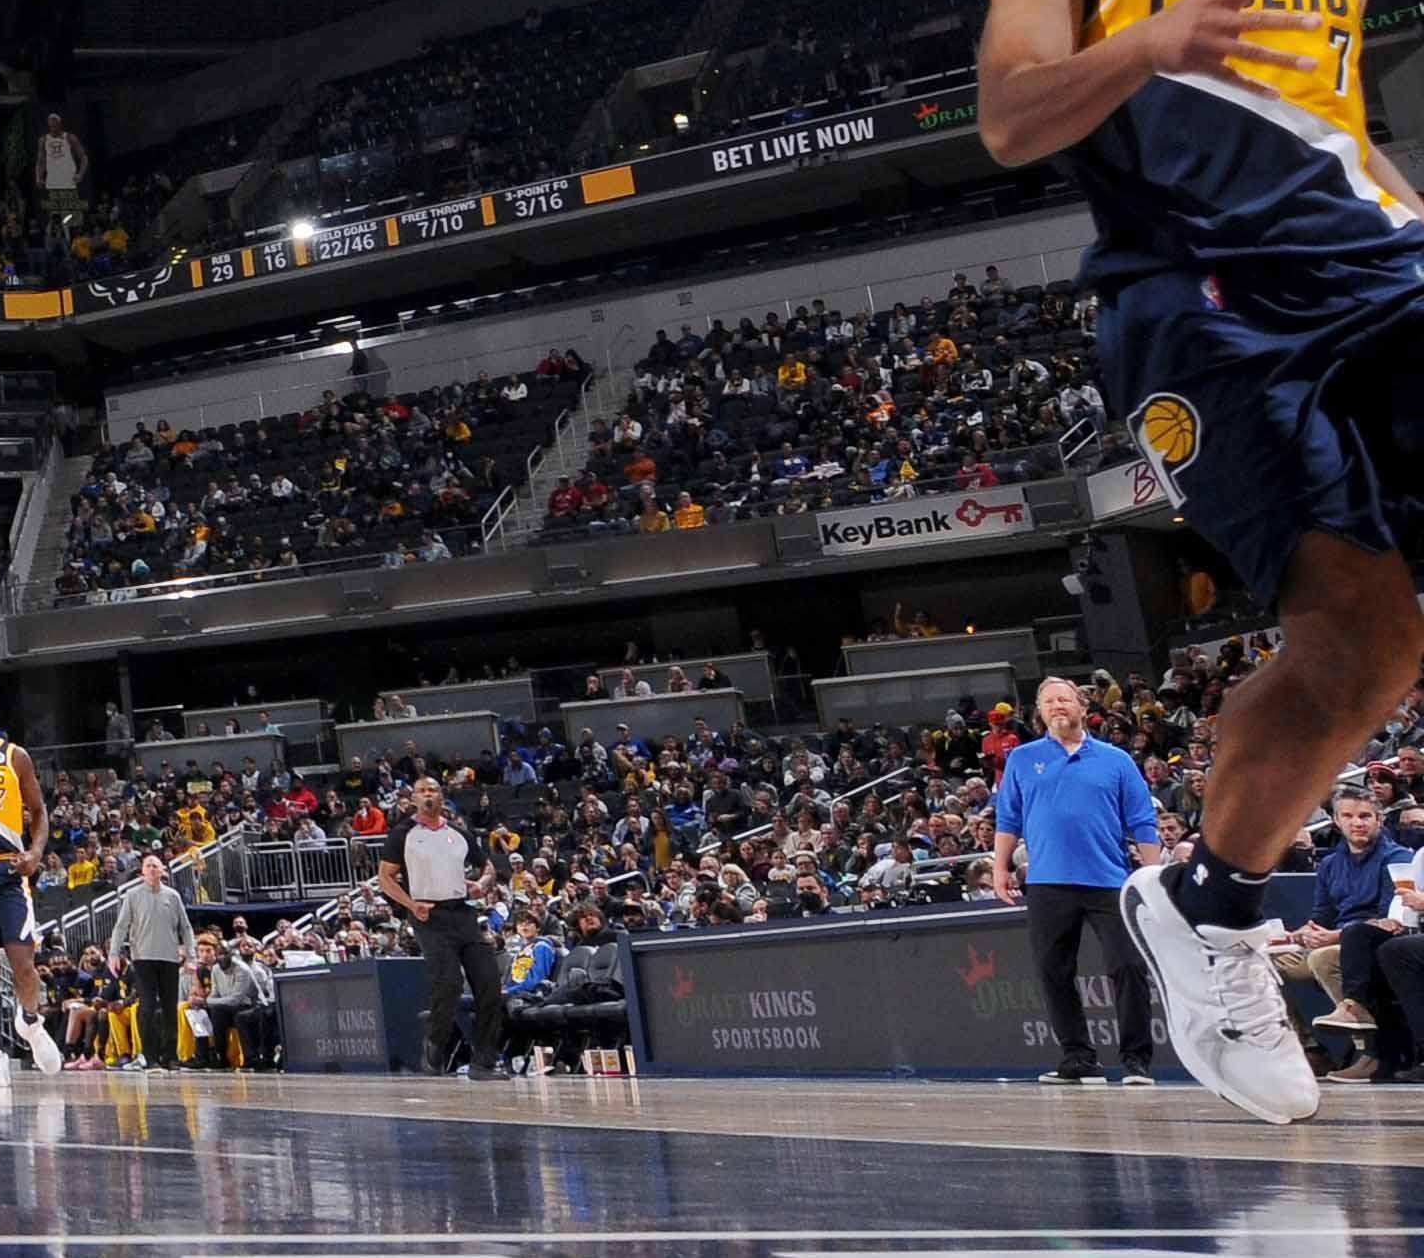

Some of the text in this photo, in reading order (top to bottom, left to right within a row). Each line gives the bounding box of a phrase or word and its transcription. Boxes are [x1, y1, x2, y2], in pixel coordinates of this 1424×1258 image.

[1329, 25, 1352, 97] 7
[712, 117, 875, 175] BET LIVE NOW
[505, 182, 548, 202] 3-POINT
[401, 200, 478, 224] FREE THROWS
[515, 195, 563, 218] 3/16
[343, 221, 378, 236] GOALS
[417, 215, 465, 239] 7/10
[264, 243, 283, 254] AST
[319, 236, 375, 260] 22/46
[211, 254, 232, 266] REB
[264, 253, 287, 272] 16
[211, 264, 234, 283] 29
[821, 510, 952, 546] KeyBank
[712, 1026, 821, 1050] SPORTSBOOK
